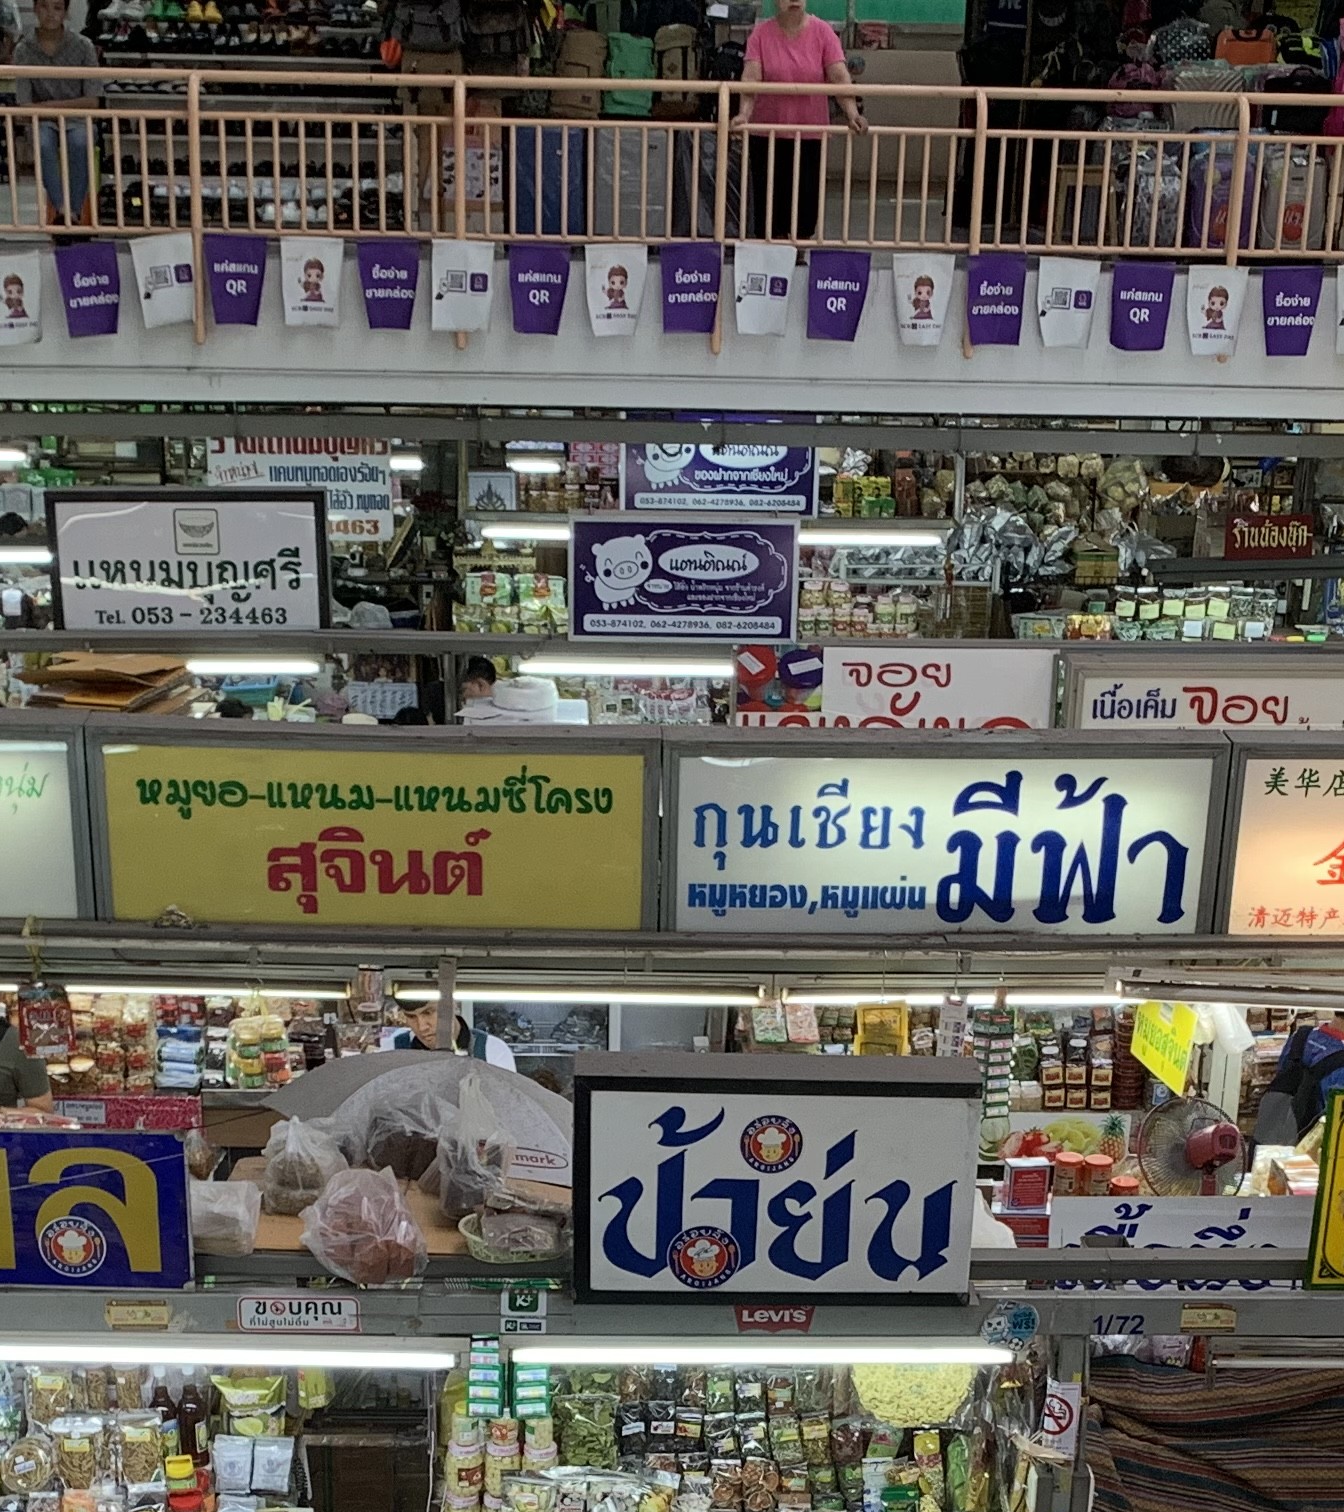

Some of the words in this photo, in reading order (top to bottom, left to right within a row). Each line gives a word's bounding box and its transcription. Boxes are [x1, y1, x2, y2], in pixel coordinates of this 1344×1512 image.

[225, 277, 249, 295] QR
[528, 288, 551, 306] QR
[825, 296, 848, 314] QR
[1128, 306, 1151, 324] QR
[841, 661, 953, 689] จอย
[1092, 685, 1179, 722] เนื้อเค็ม
[1181, 685, 1290, 727] จอย
[692, 777, 927, 872] กุนเชียง
[935, 769, 1191, 925] มีฟ้า
[266, 825, 493, 915] สุจินต์
[598, 1104, 959, 1283] ป้าย่น
[1092, 1313, 1146, 1336] 1/72
